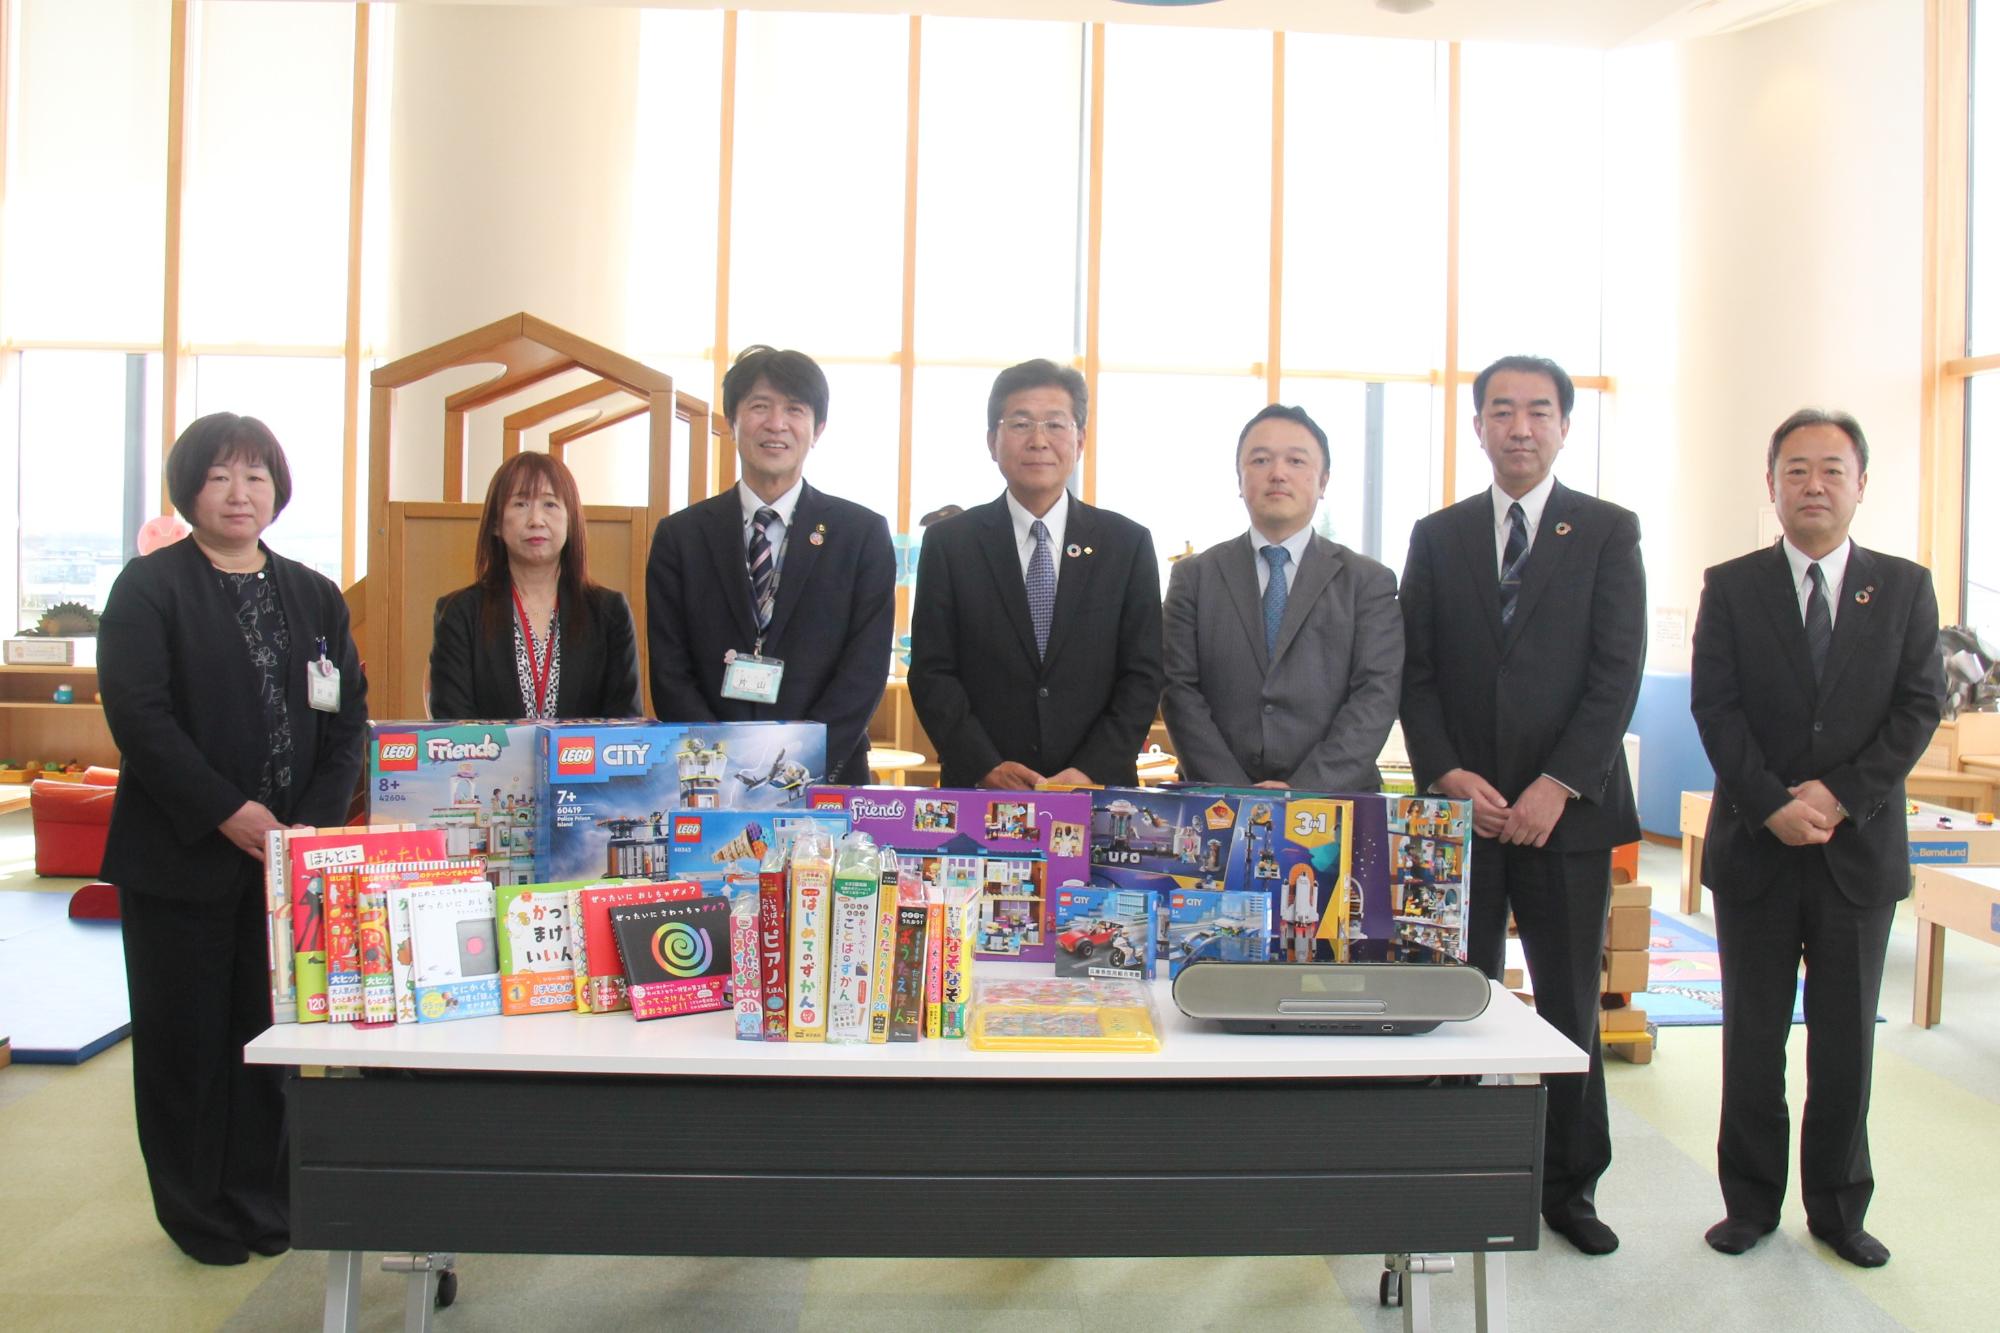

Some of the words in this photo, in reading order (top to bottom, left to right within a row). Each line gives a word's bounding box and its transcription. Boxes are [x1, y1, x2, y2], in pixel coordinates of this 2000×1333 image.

[381, 744, 416, 760] LEGO
[426, 734, 501, 760] Friends
[602, 744, 651, 766] CITY
[560, 748, 593, 764] LEGO
[379, 778, 400, 791] 8+
[379, 794, 407, 802] 42604
[557, 790, 577, 804] 7+
[557, 806, 582, 814] 60419
[851, 797, 906, 822] Friends
[677, 824, 700, 835] LEGO
[308, 848, 358, 867] ほんとに
[1108, 850, 1141, 864] UFO
[591, 893, 633, 904] ぜったいに
[1073, 896, 1090, 905] CITY
[533, 905, 568, 920] かっ
[616, 911, 658, 922] ぜったいに
[769, 898, 778, 926] いちばん
[534, 925, 571, 943] まけ
[763, 929, 781, 985] ピアノ
[799, 897, 817, 1009] はじめてのずかん
[840, 918, 856, 1002] ことばのずかん
